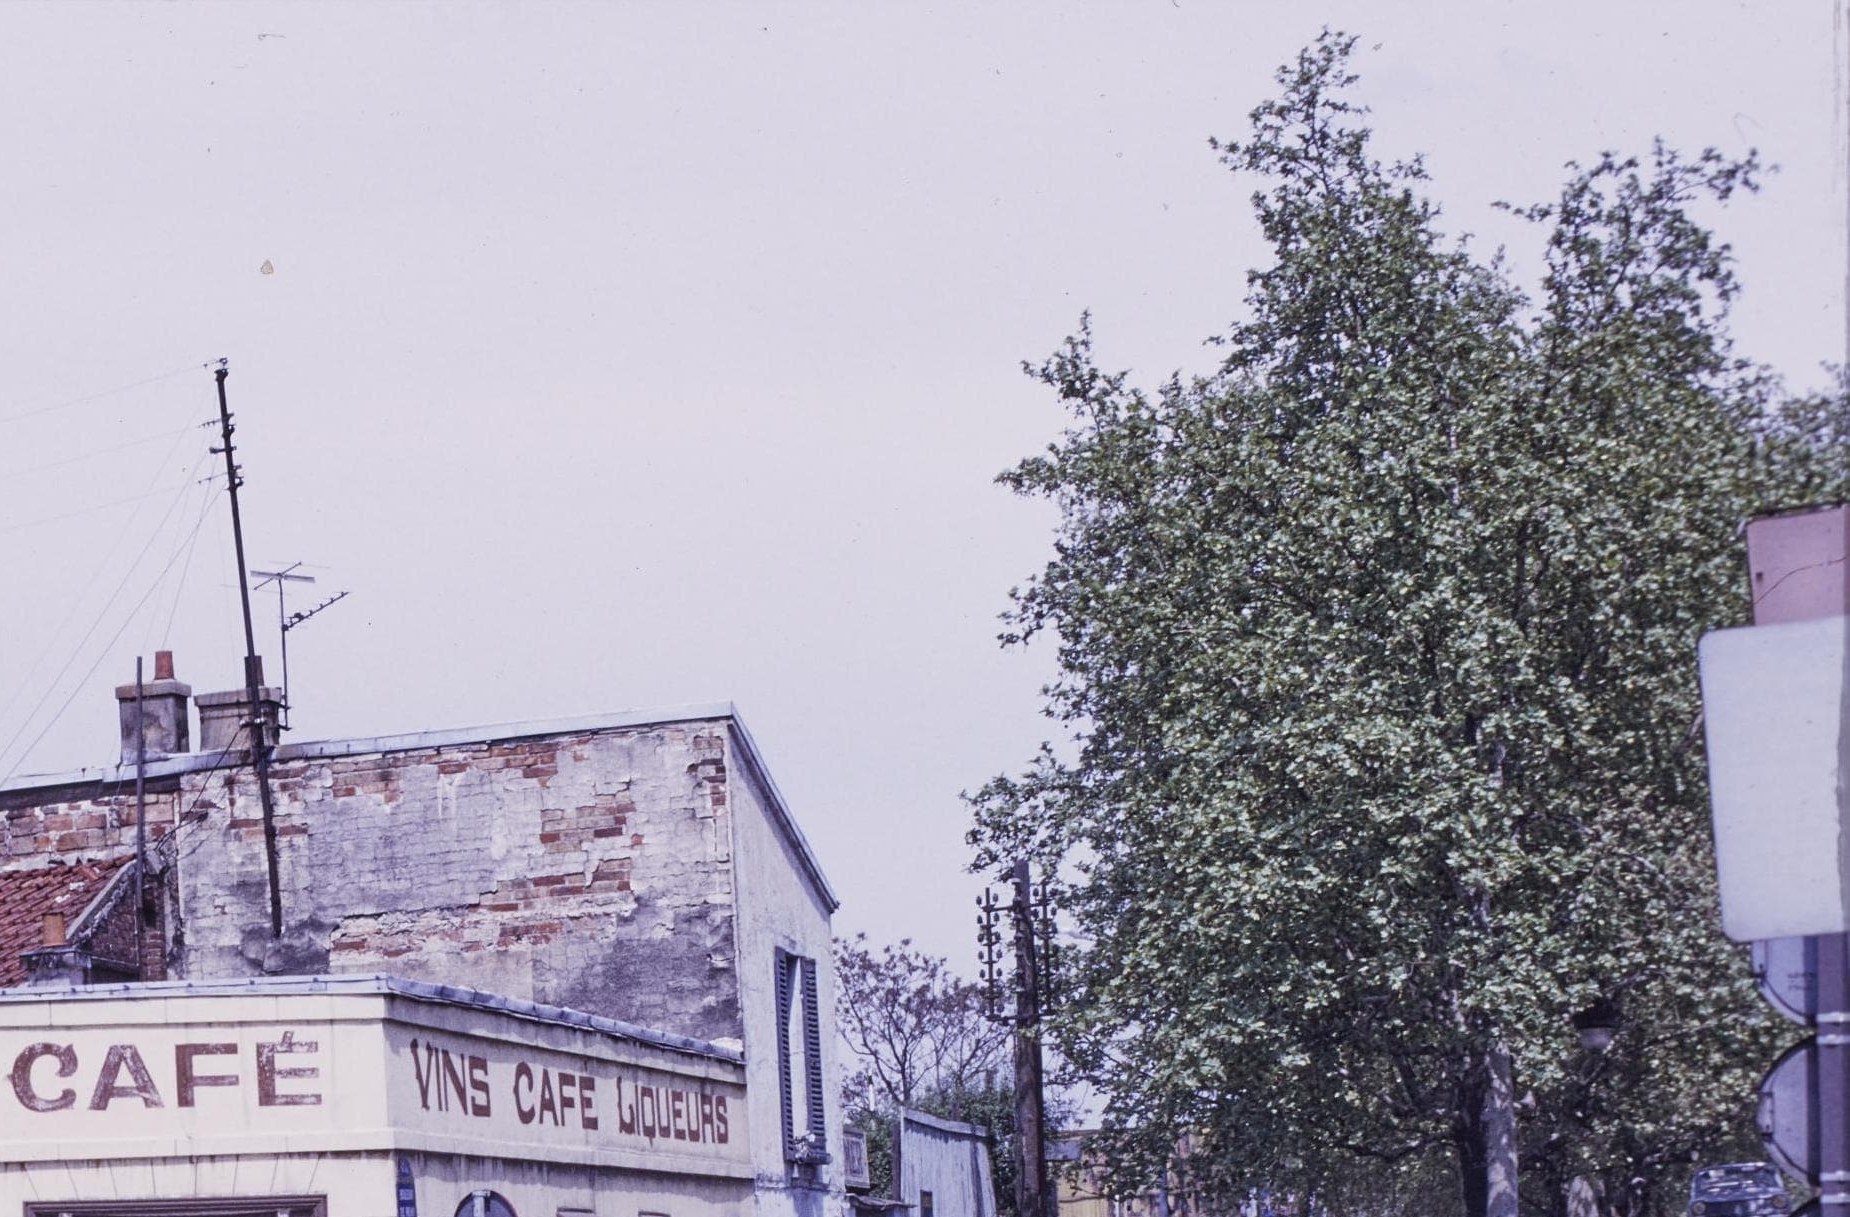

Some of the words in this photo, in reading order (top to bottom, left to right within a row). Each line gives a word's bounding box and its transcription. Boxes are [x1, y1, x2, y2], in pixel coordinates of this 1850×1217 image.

[5, 1031, 323, 1113] CAFÉ
[410, 1038, 491, 1118] VINS
[616, 1076, 728, 1148] LIQUEURS
